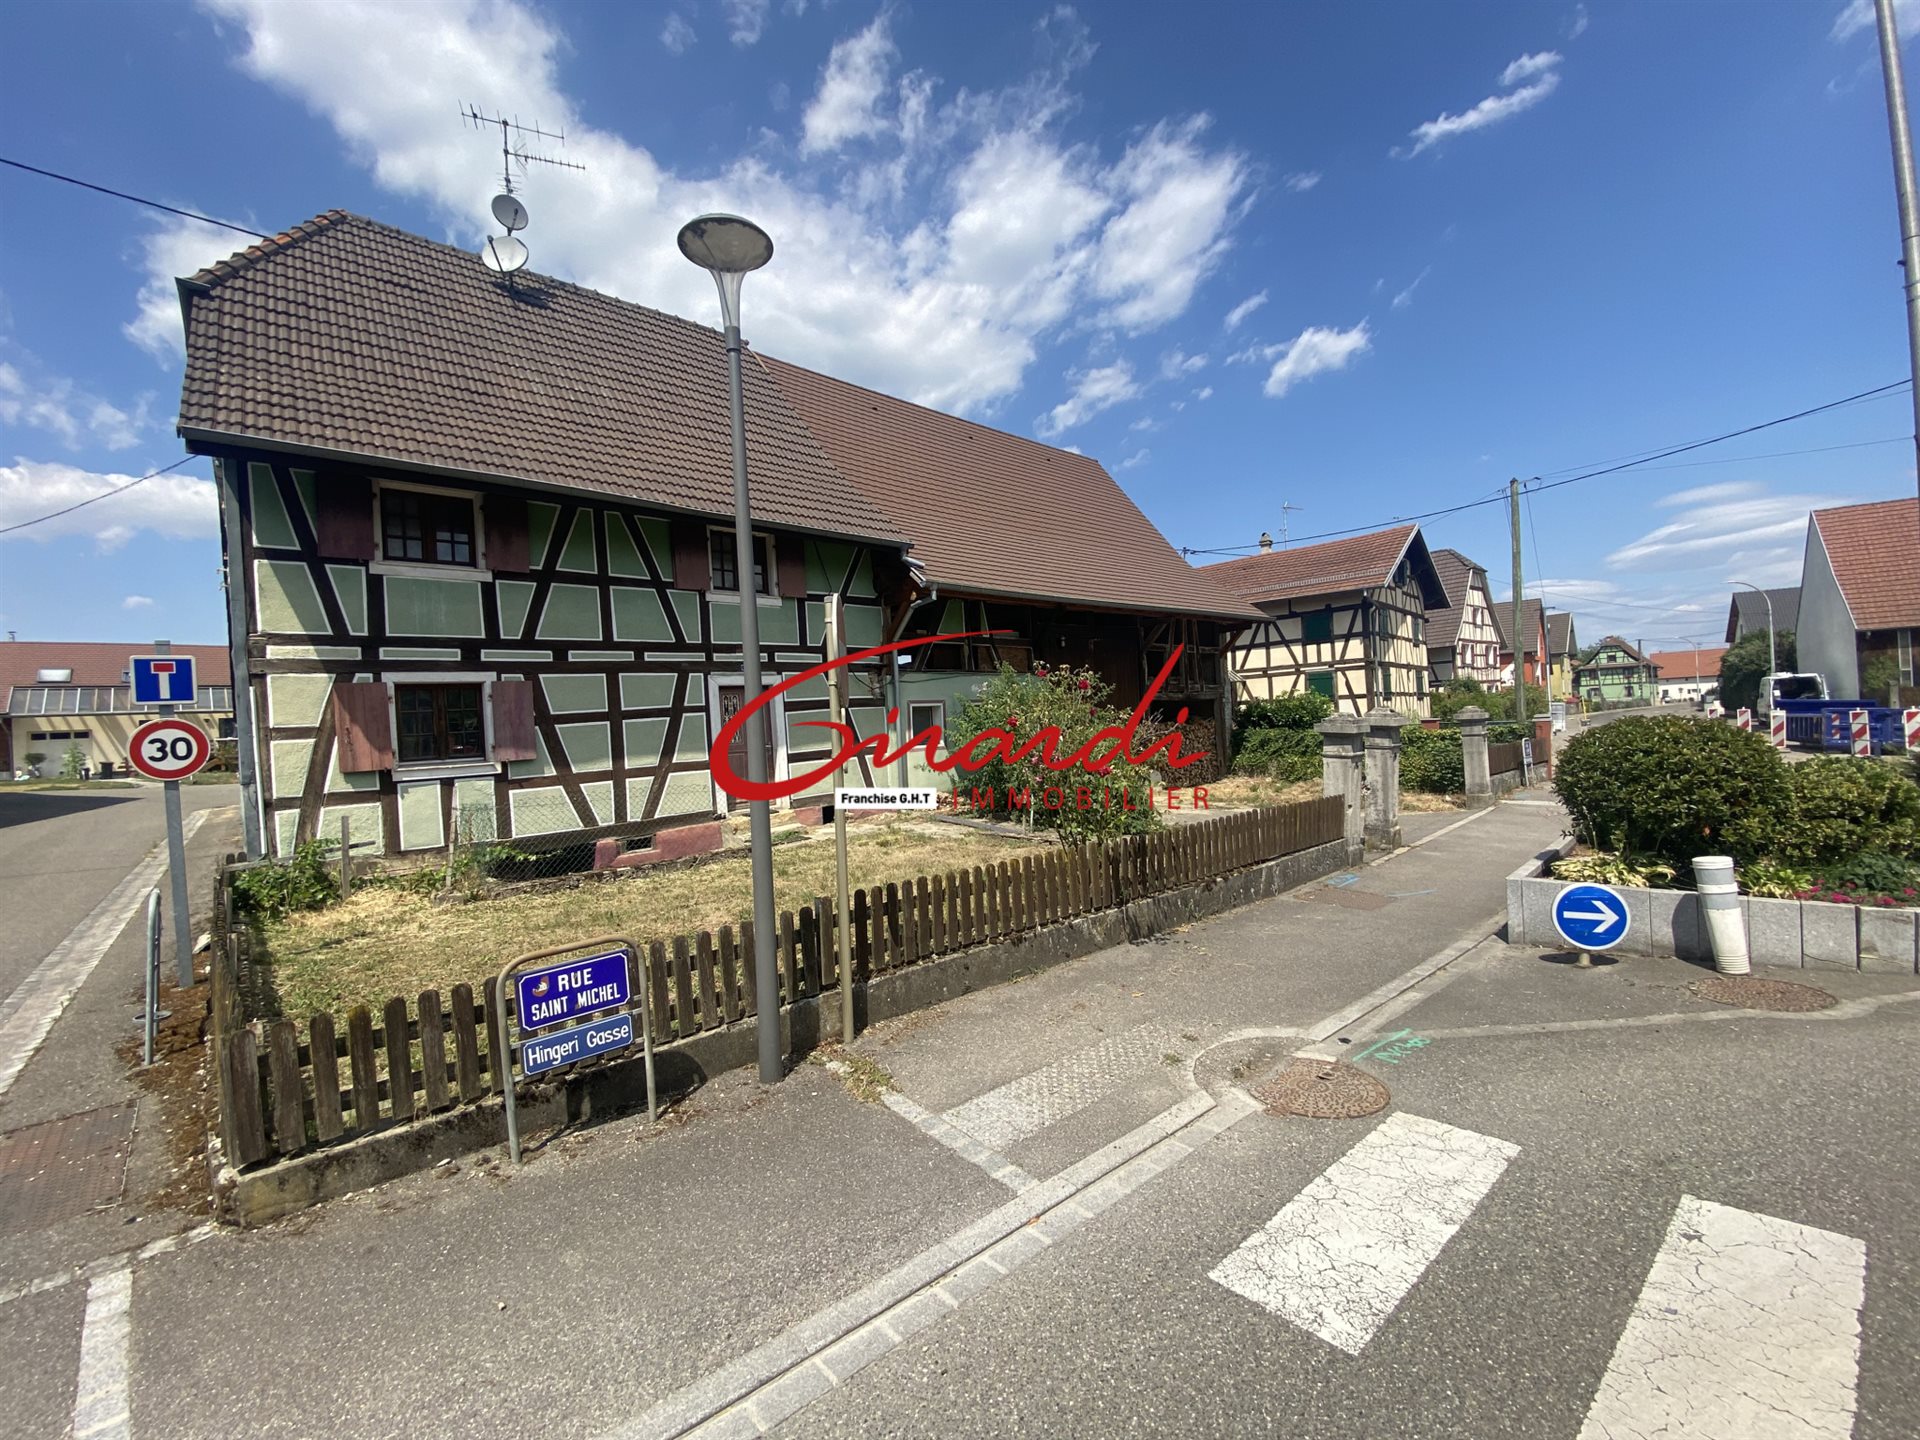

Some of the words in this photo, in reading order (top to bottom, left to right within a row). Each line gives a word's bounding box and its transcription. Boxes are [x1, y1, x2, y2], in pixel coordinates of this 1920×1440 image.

[147, 736, 194, 763] 30
[557, 968, 593, 992] RUE
[531, 996, 568, 1021] SAINT
[577, 983, 620, 1008] MICHEL
[528, 1036, 579, 1065] Hingeri
[587, 1025, 629, 1048] Gasse
